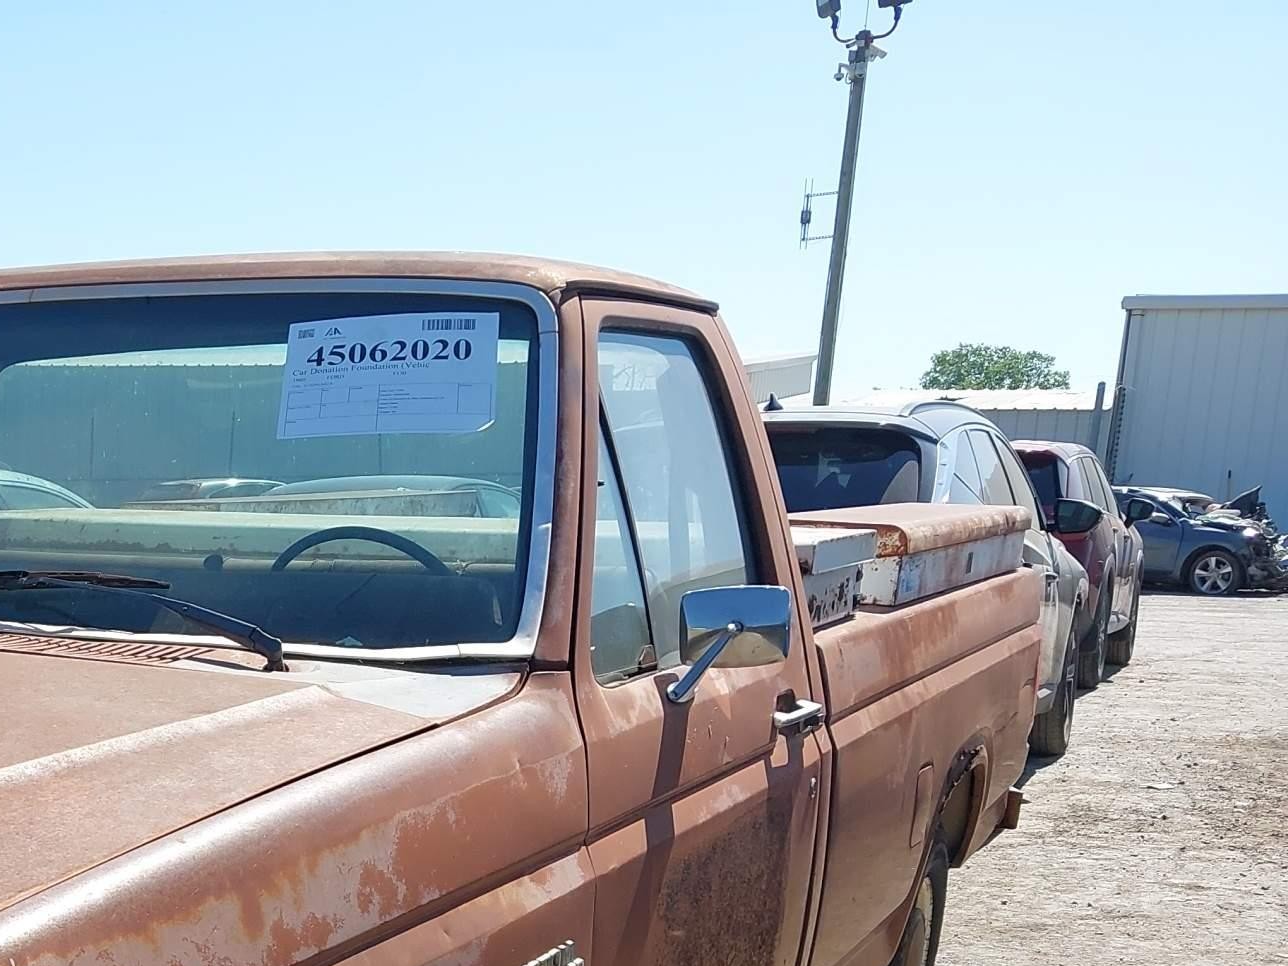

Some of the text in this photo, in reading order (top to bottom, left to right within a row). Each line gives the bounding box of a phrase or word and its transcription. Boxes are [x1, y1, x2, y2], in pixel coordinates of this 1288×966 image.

[306, 338, 473, 367] 45062020
[310, 366, 349, 376] Donation
[351, 362, 400, 372] Foundation
